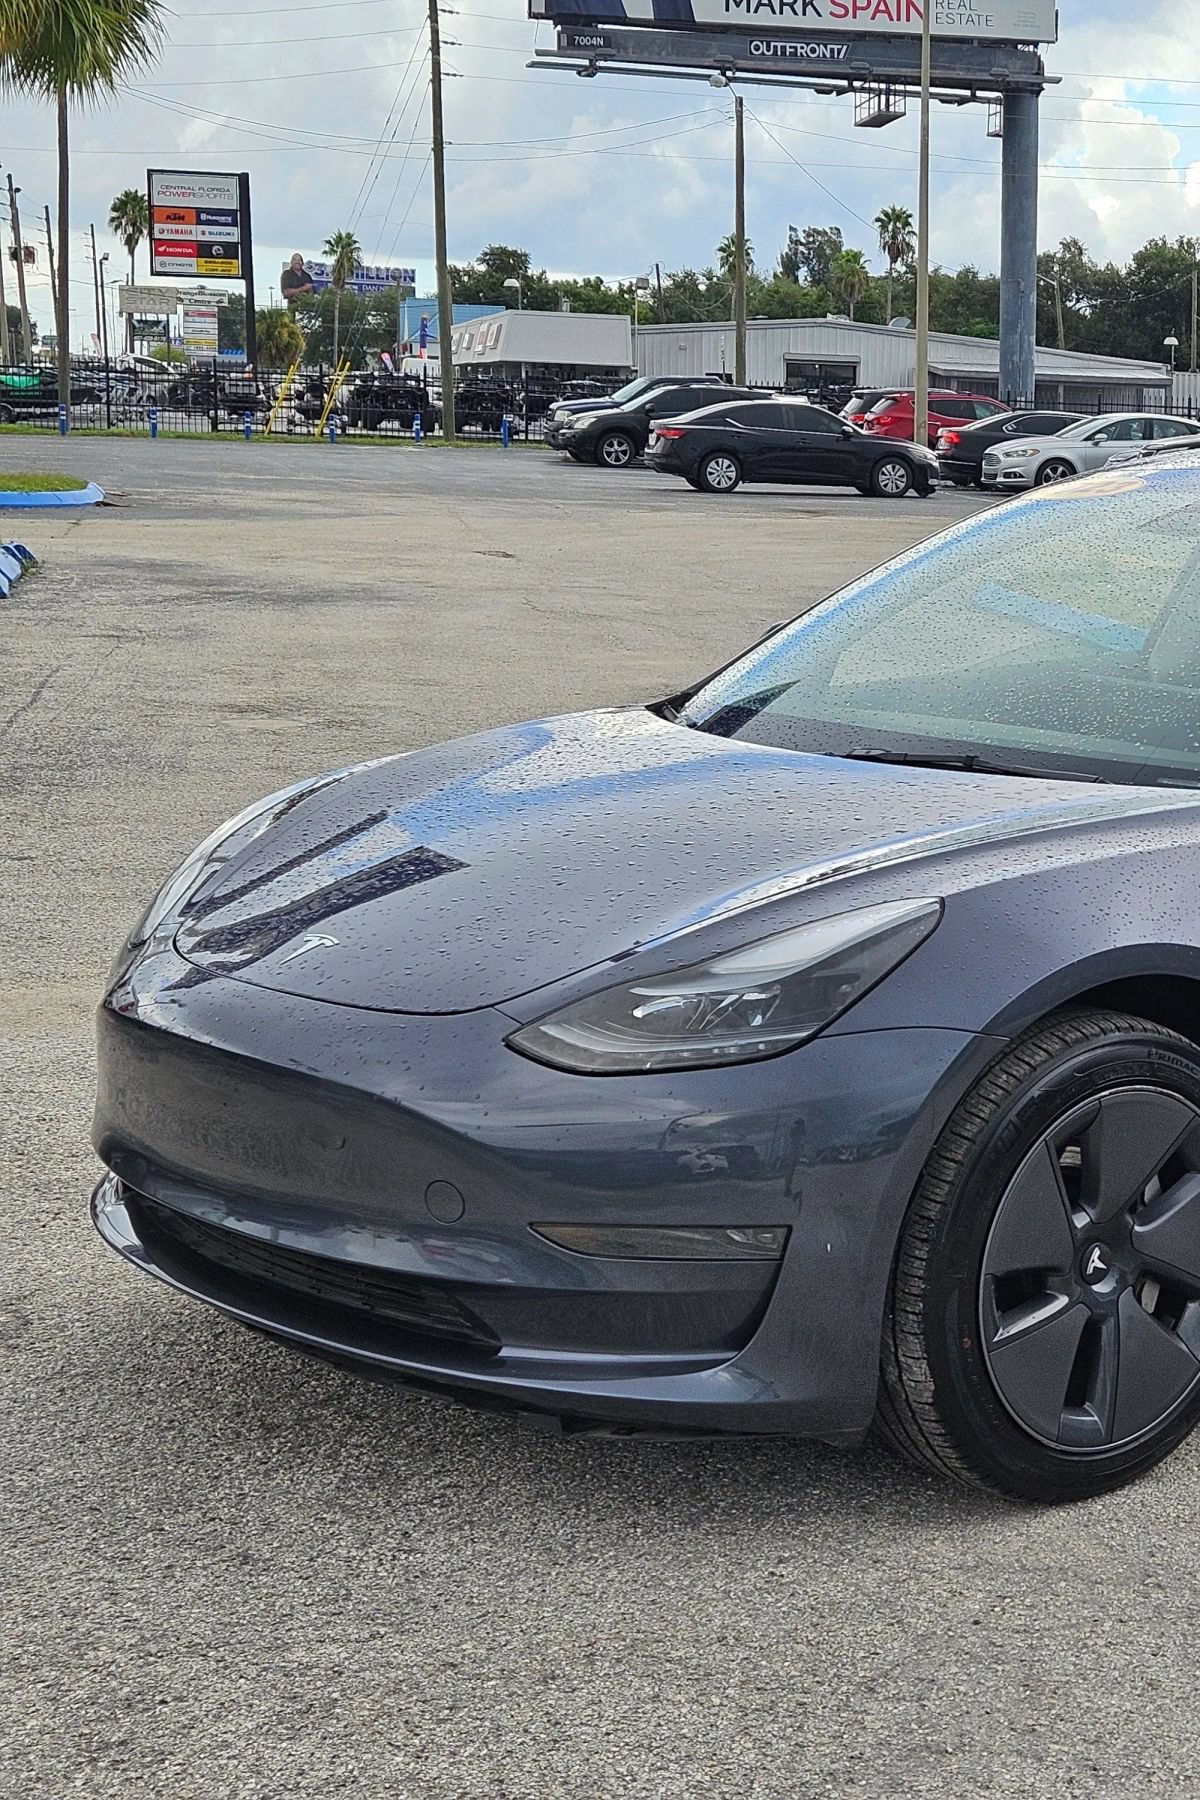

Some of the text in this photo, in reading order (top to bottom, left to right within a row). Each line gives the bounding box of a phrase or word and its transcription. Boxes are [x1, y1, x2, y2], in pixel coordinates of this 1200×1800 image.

[935, 0, 977, 11] REAL
[724, 0, 924, 22] MARK SPAIN
[935, 12, 994, 27] ESTATE
[573, 36, 604, 47] 7004N
[160, 184, 196, 192] CENTRAL
[157, 190, 234, 200] POWERSPORTS
[165, 212, 186, 222] KTM
[166, 227, 193, 236] YAMAHA
[126, 287, 169, 296] CITY
[126, 296, 170, 305] STAR
